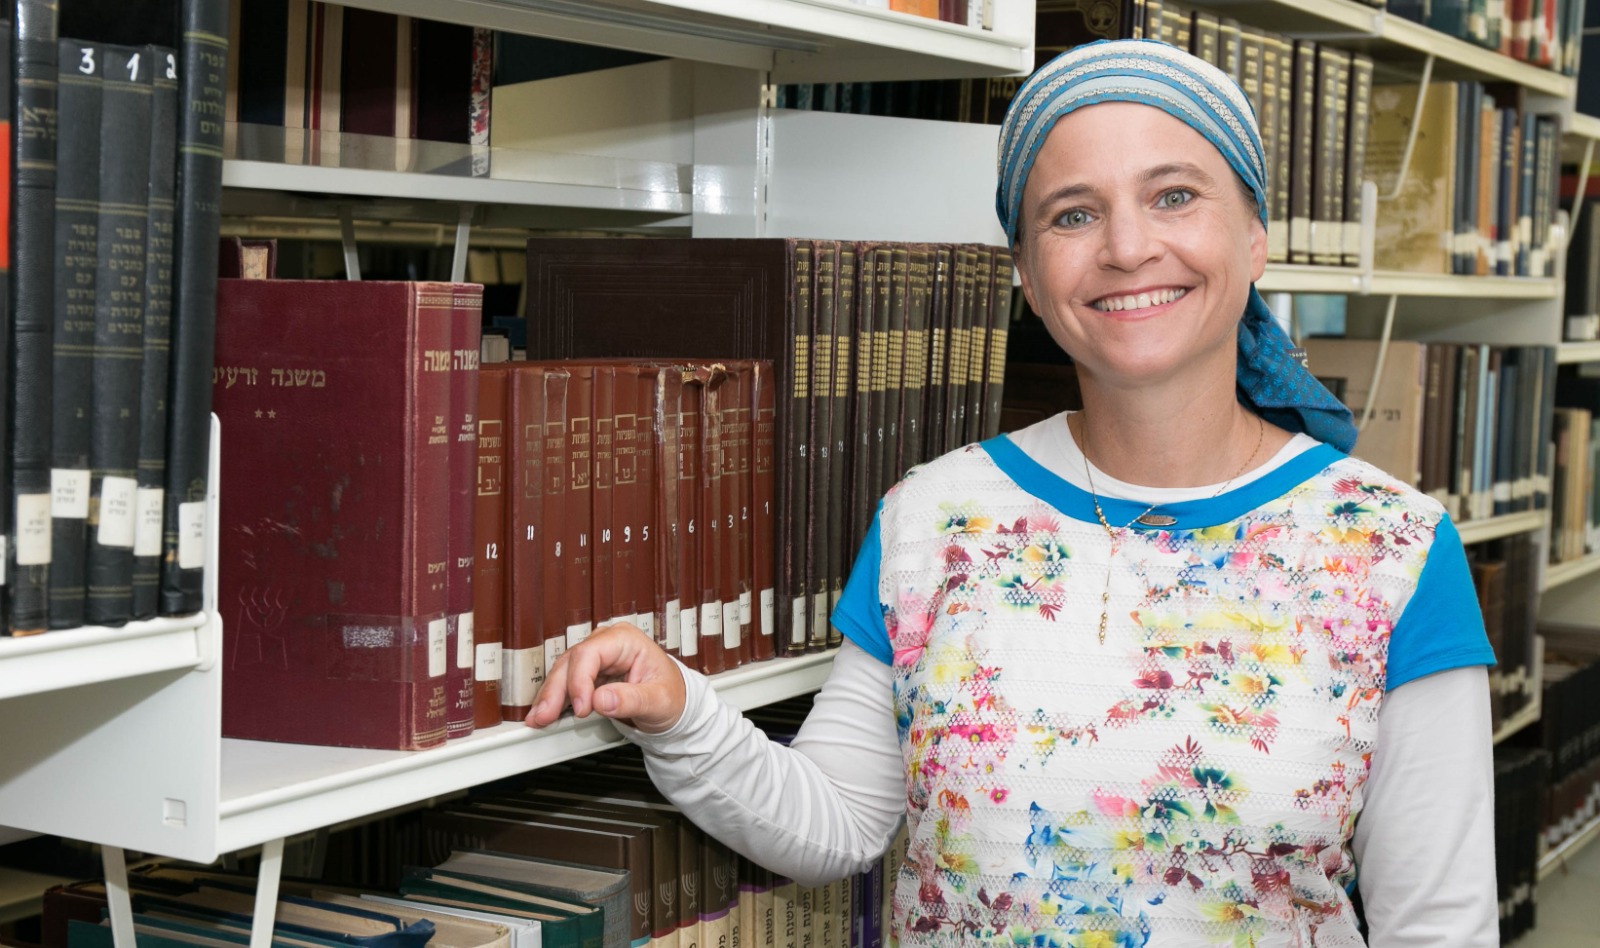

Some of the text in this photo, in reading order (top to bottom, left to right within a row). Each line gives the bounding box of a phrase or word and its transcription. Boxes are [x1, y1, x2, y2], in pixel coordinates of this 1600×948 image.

[79, 47, 96, 75] 3
[126, 53, 140, 82] 1
[166, 54, 178, 79] 2
[271, 367, 326, 388] משנה
[477, 436, 502, 448] משניות
[878, 427, 883, 443] 9
[485, 478, 496, 490] יב
[741, 506, 748, 520] 2
[764, 501, 769, 515] 1
[688, 519, 695, 534] 6
[711, 519, 718, 532] 4
[728, 514, 734, 529] 3
[526, 525, 535, 540] 11
[580, 534, 587, 547] 11
[602, 528, 611, 543] 10
[624, 525, 631, 542] 9
[642, 525, 650, 541] 5
[486, 543, 498, 560] 12
[555, 541, 562, 557] 8
[803, 891, 811, 928] משנת
[841, 877, 849, 934] שנת ארץ
[765, 908, 773, 945] משנת
[786, 900, 794, 937] משנת
[823, 920, 831, 946] ארץ
